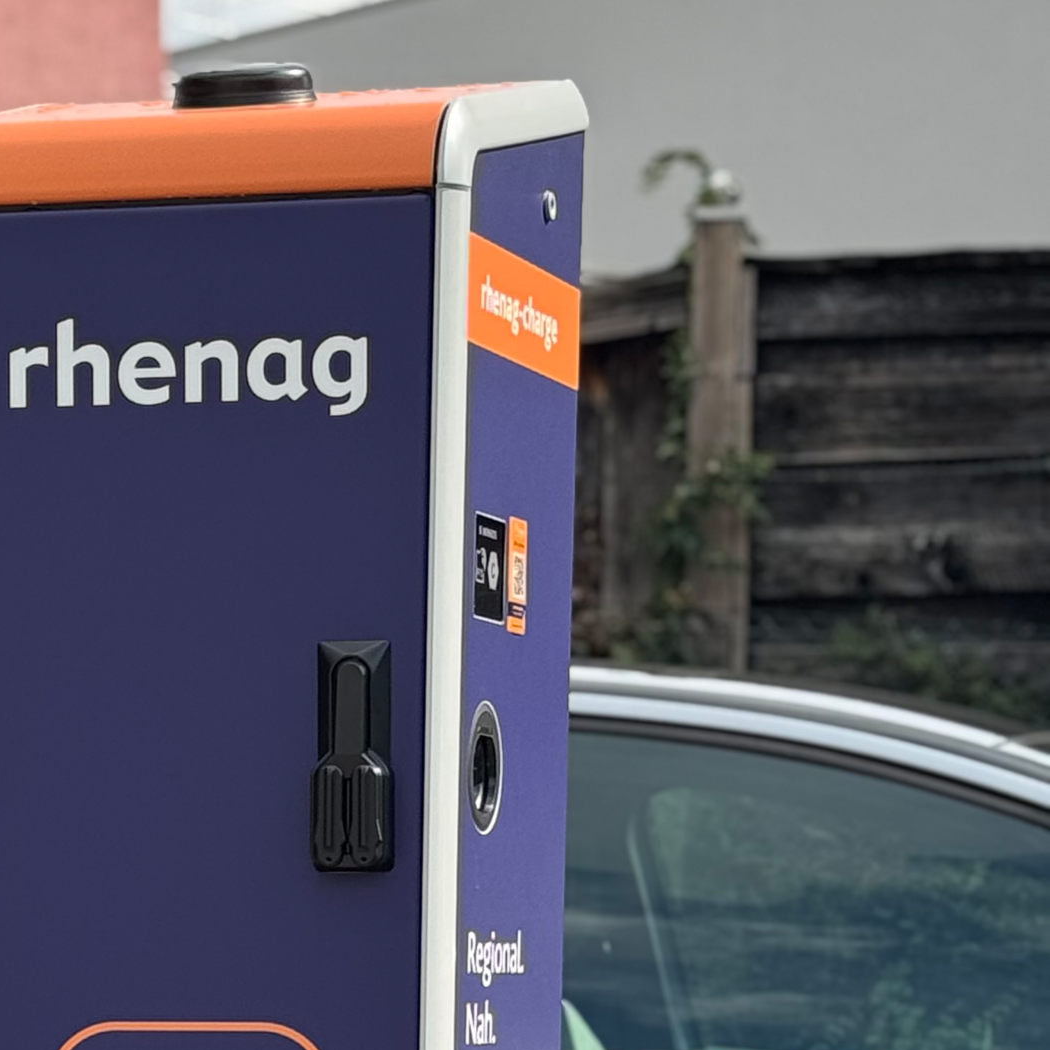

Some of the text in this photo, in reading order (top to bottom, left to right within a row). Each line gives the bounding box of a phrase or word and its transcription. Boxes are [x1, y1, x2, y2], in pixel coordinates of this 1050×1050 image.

[480, 274, 558, 352] rhenag-charge
[8, 317, 369, 416] rhenag
[466, 929, 525, 987] Regional.
[465, 999, 497, 1045] Nah.
